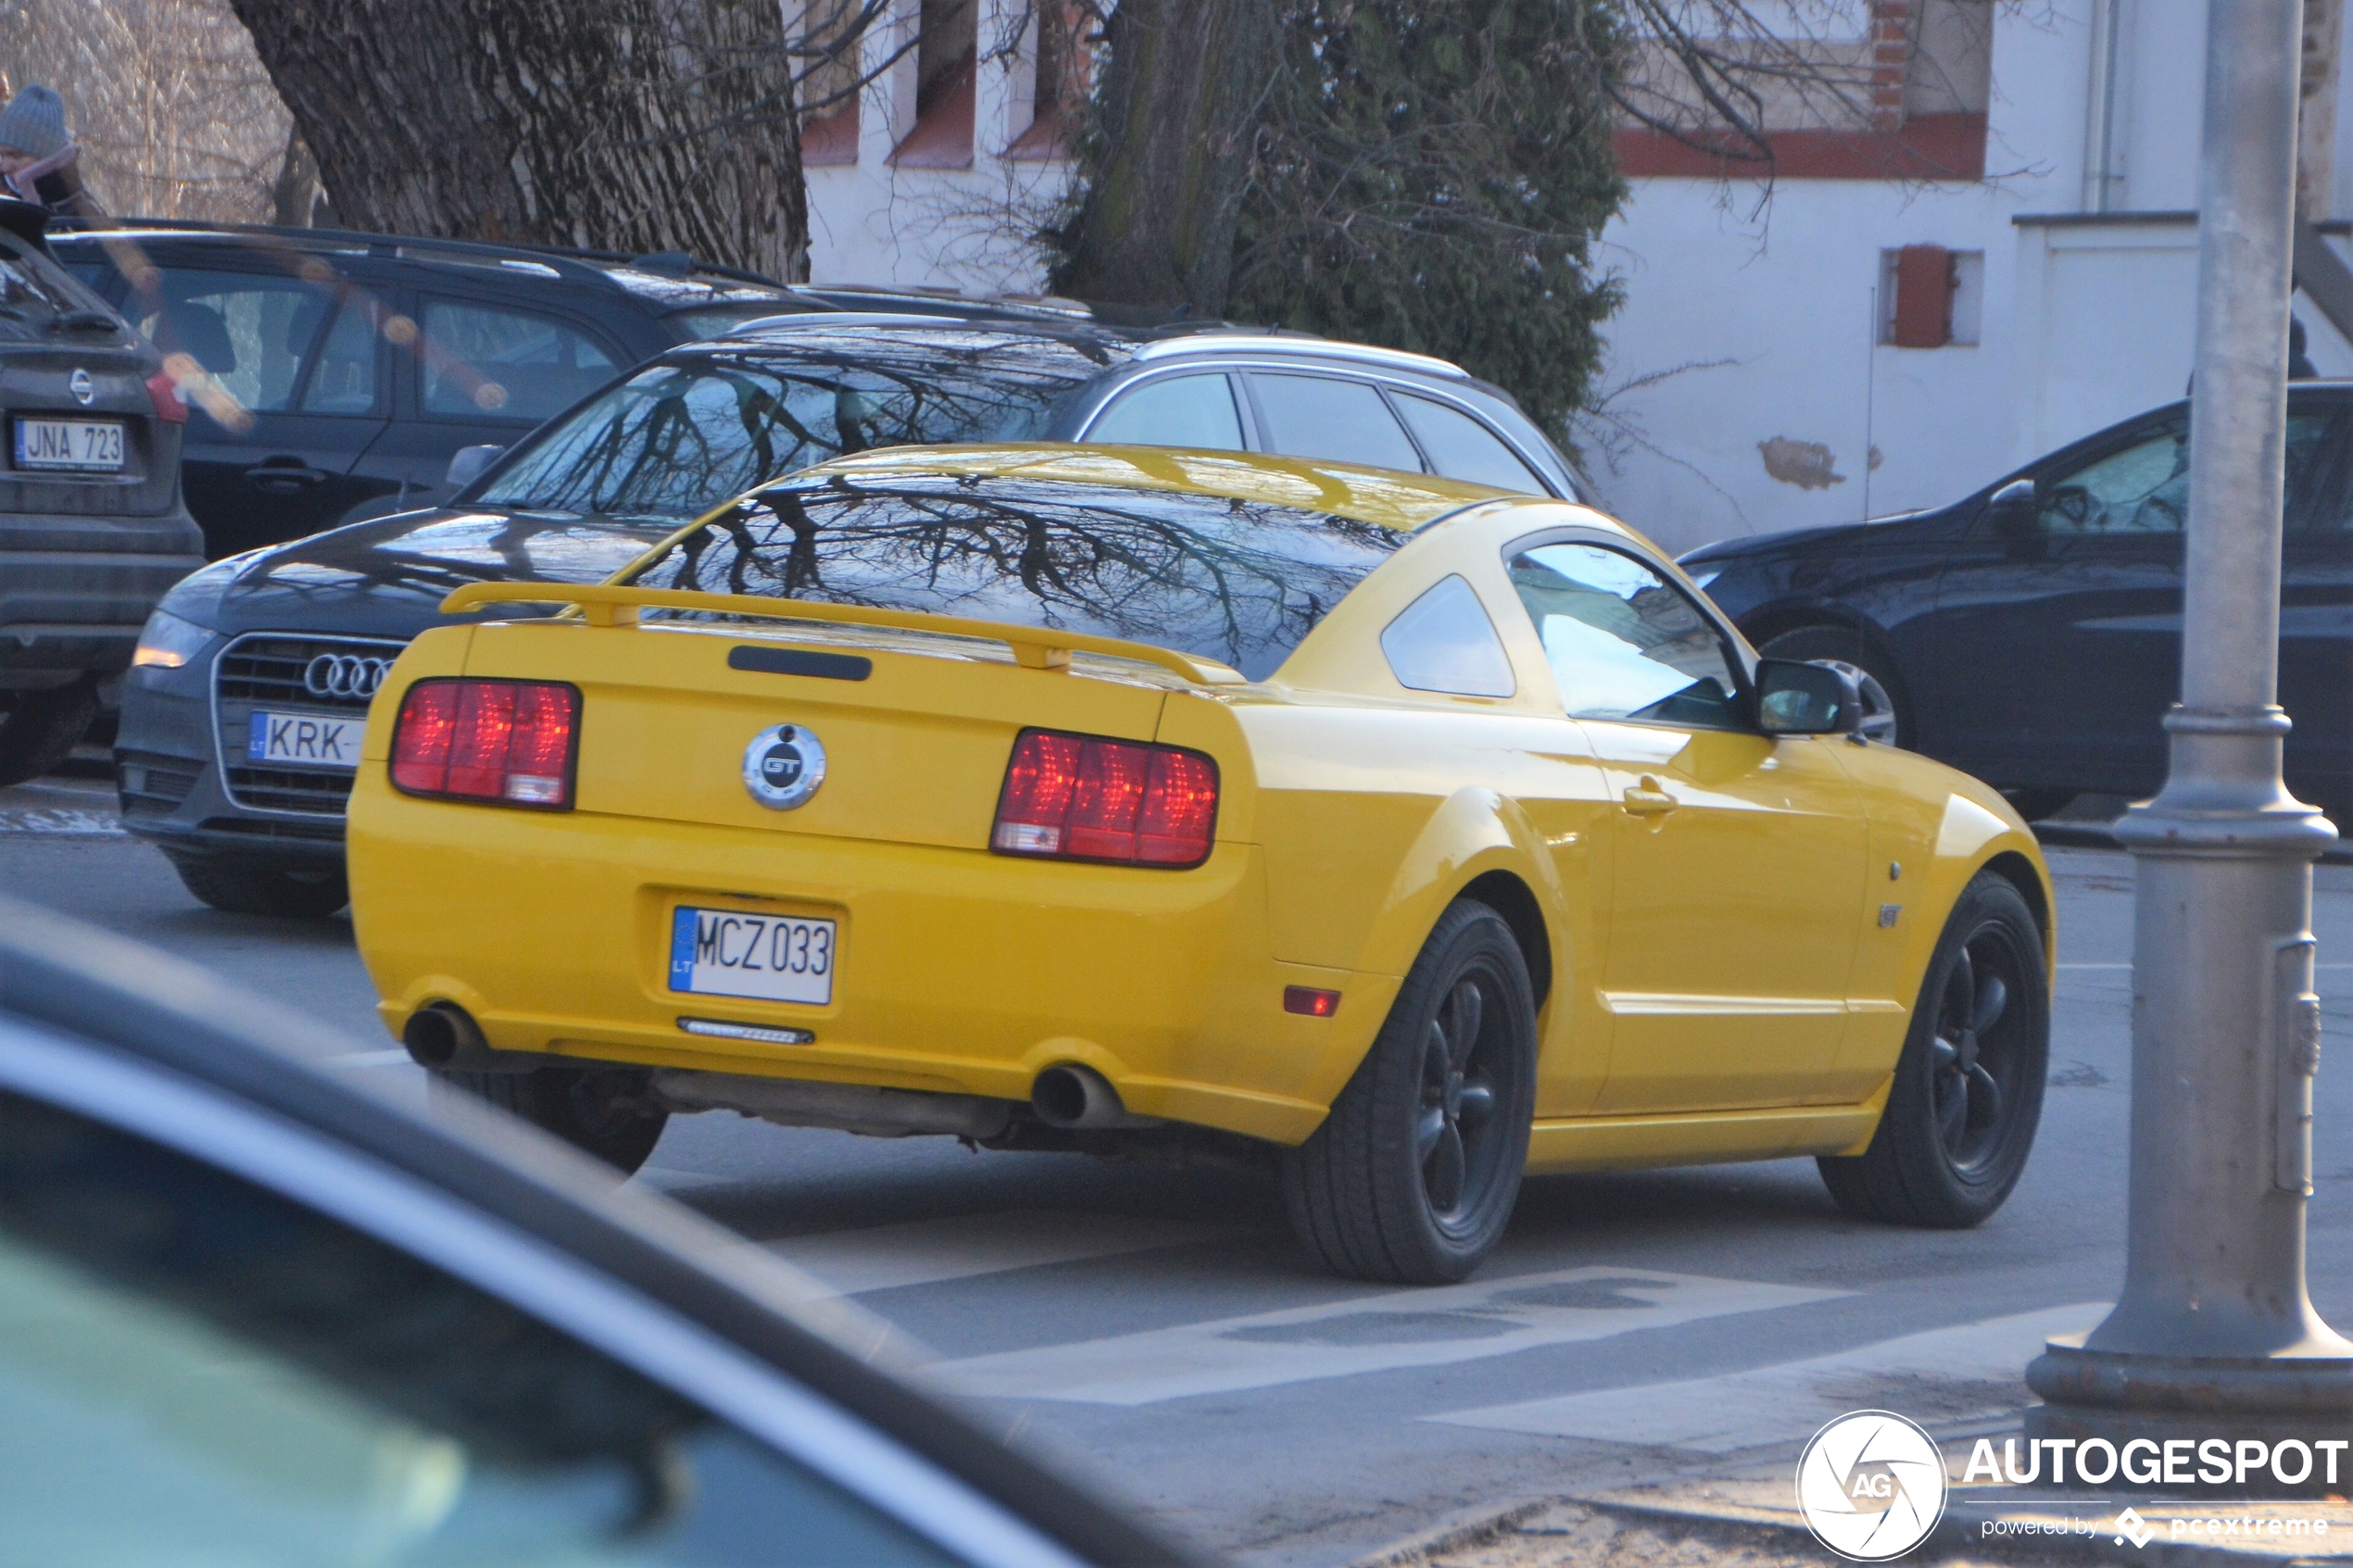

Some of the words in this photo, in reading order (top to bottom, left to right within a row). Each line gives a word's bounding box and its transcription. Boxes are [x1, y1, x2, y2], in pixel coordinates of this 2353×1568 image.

[28, 424, 71, 458] JNA
[85, 426, 120, 460] 723
[763, 757, 801, 774] GT
[695, 914, 767, 971] MCZ
[771, 921, 830, 976] 033
[672, 960, 693, 973] LT
